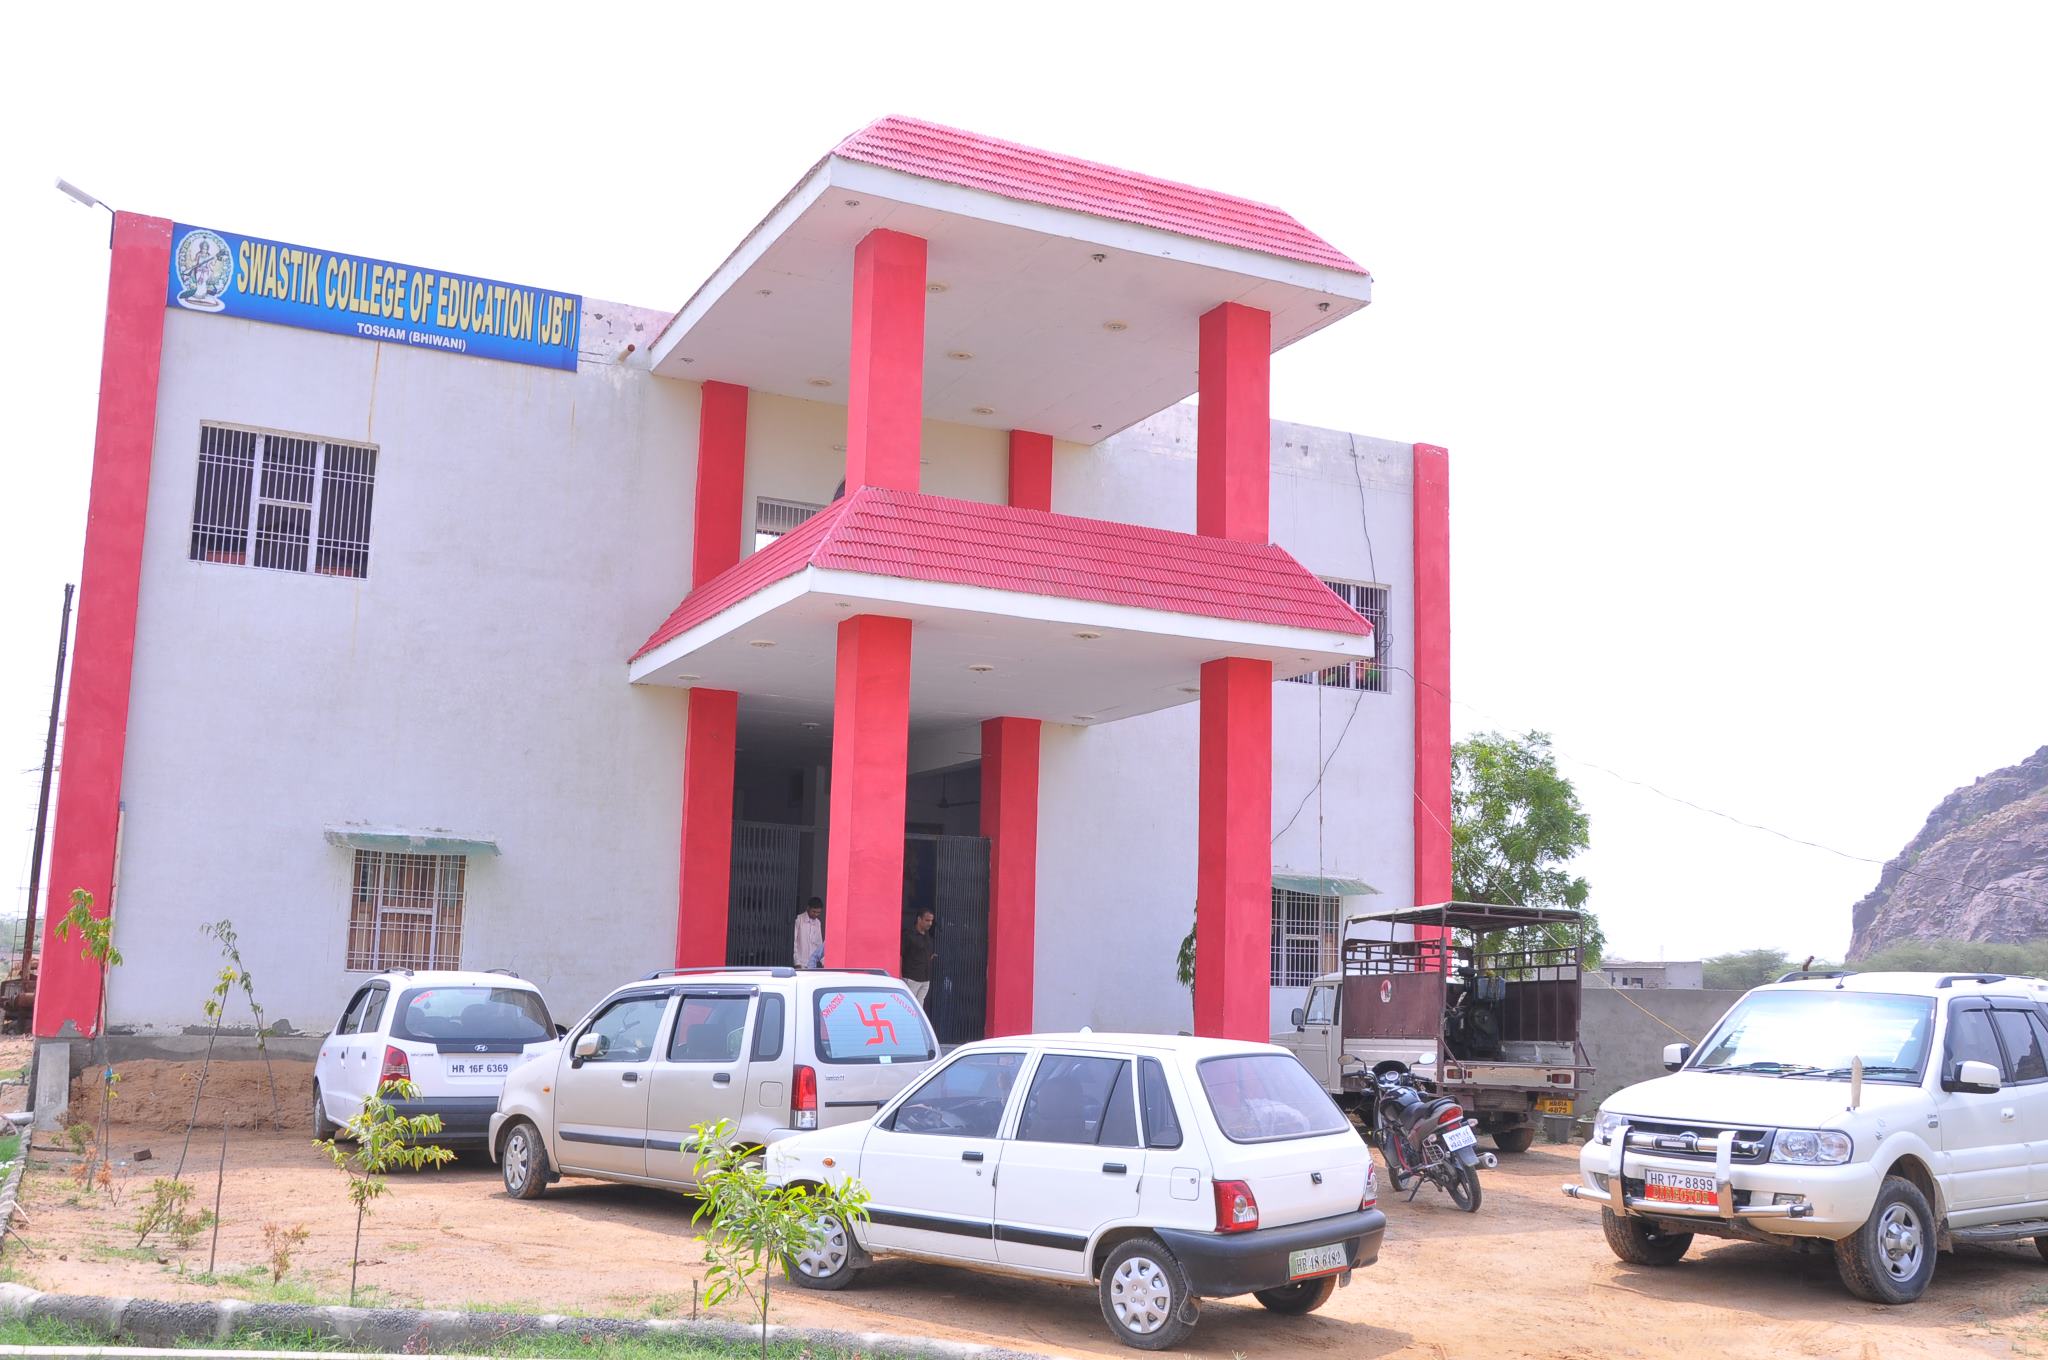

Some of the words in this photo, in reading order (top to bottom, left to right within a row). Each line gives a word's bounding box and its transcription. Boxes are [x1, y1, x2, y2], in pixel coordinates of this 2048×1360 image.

[237, 240, 323, 307] SWASTIK
[325, 256, 407, 320] COLLEGE
[409, 272, 434, 324] OF
[436, 277, 535, 342] EDUCATION
[537, 292, 578, 352] (JBT)
[356, 322, 406, 341] TOSHAM
[408, 331, 467, 352] (BHIWANI)
[451, 1064, 465, 1074] HR
[469, 1064, 484, 1074] 16F
[486, 1063, 509, 1074] 6369
[1650, 1172, 1664, 1185] HR
[1296, 1257, 1308, 1273] HR
